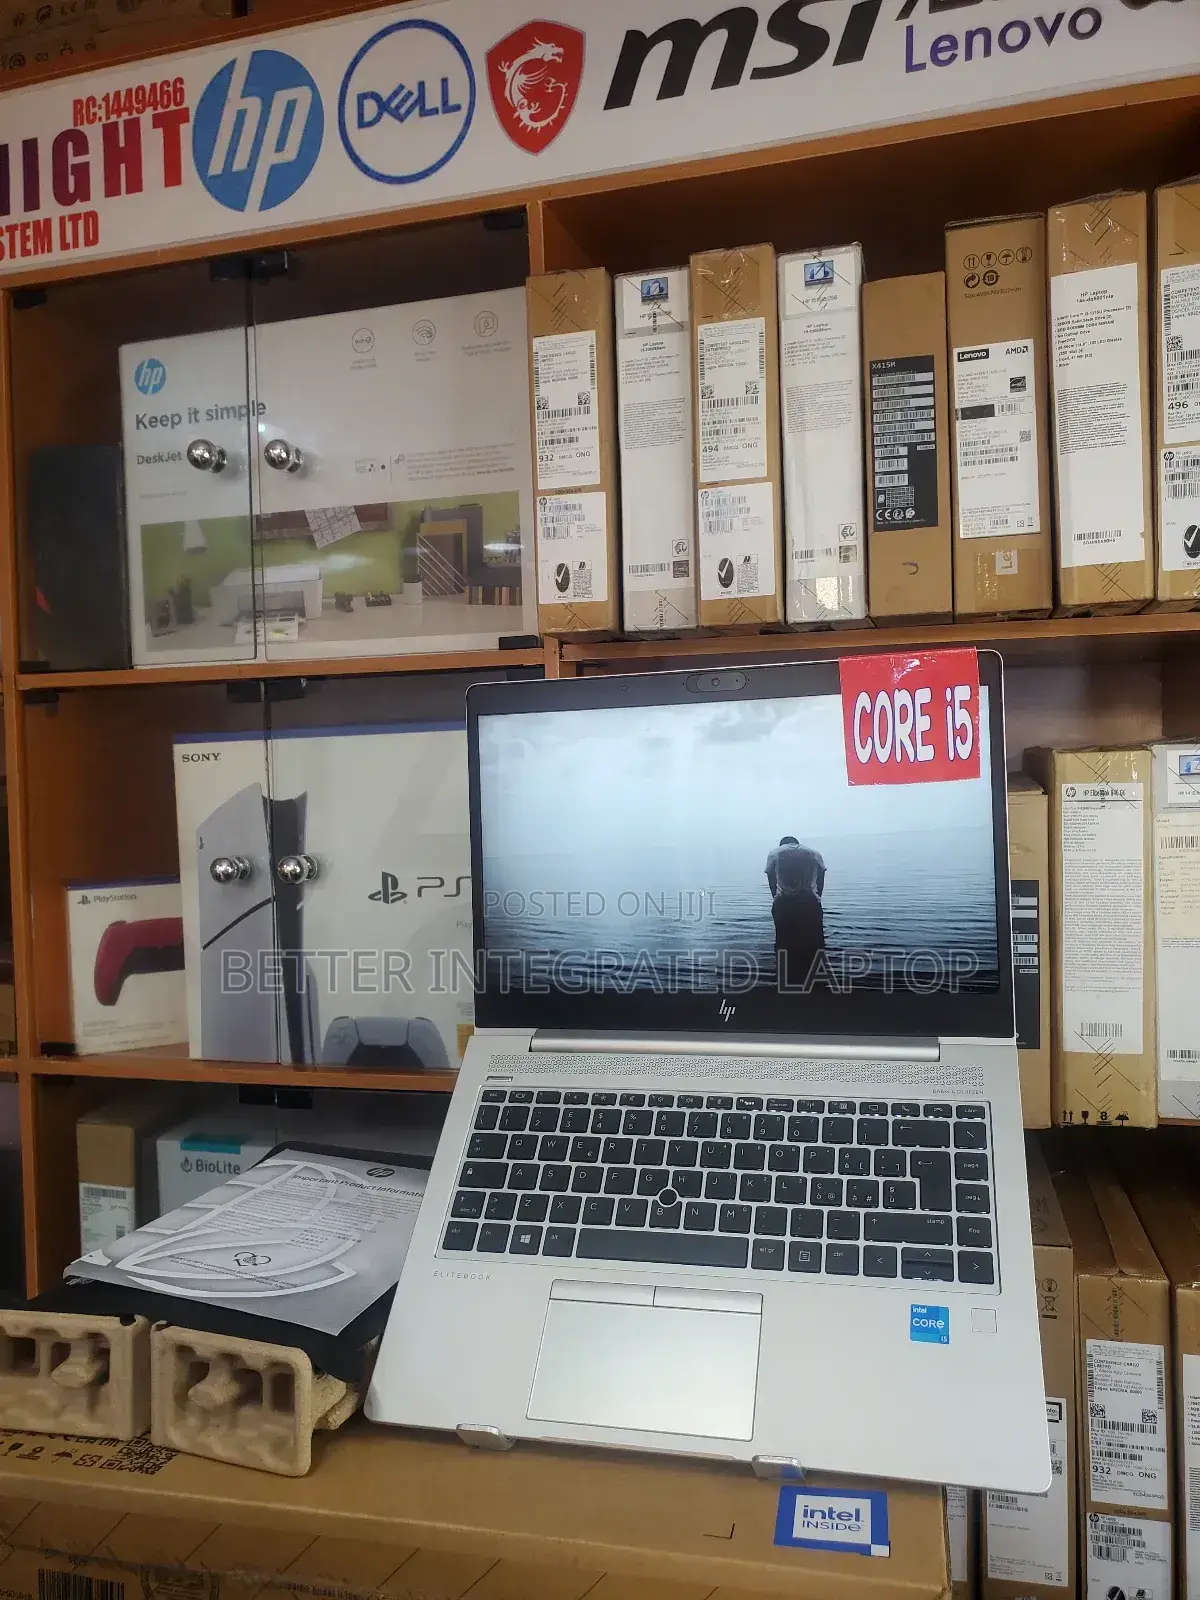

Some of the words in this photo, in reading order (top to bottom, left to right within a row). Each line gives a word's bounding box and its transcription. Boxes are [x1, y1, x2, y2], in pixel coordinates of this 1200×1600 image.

[904, 6, 1103, 74] Lenovo
[603, 0, 882, 111] msi
[72, 76, 186, 127] RC:1449466
[356, 75, 462, 130] DELL
[58, 209, 100, 252] LTD
[1090, 289, 1108, 297] Laptop
[959, 350, 987, 361] Lenovo
[1005, 346, 1022, 356] AMD
[871, 361, 896, 370] X415M
[1167, 400, 1189, 411] 496
[135, 412, 183, 431] Keep
[187, 406, 201, 425] it
[204, 399, 268, 424] simple
[702, 444, 719, 453] 494
[135, 450, 184, 467] DeskJet
[538, 453, 555, 463] 932
[852, 685, 937, 765] CORE
[945, 684, 974, 762] i5
[180, 751, 222, 764] SONY
[93, 893, 138, 904] PlayStation
[534, 1119, 541, 1127] 2
[565, 1120, 571, 1128] 3
[515, 1139, 523, 1147] Q
[608, 1142, 616, 1150] R
[641, 1143, 647, 1151] T
[707, 1146, 715, 1154] U
[775, 1149, 784, 1157] O
[809, 1151, 817, 1159] P
[194, 1157, 242, 1176] BioLite
[292, 1174, 339, 1185] Important
[339, 1180, 377, 1191] Product
[515, 1168, 523, 1176] A
[547, 1169, 554, 1177] S
[579, 1171, 587, 1179] D
[611, 1172, 619, 1180] F
[645, 1173, 653, 1182] G
[678, 1175, 686, 1183] H
[711, 1177, 718, 1185] J
[746, 1179, 754, 1187] K
[781, 1181, 788, 1189] L
[524, 1199, 532, 1207] Z
[556, 1201, 564, 1209] X
[590, 1202, 597, 1210] C
[624, 1204, 632, 1212] V
[656, 1207, 664, 1216] B
[691, 1208, 699, 1216] N
[726, 1209, 736, 1218] M
[926, 1217, 945, 1226] stamp
[433, 1270, 492, 1281] ELITEBOOK
[912, 1306, 928, 1314] intel
[1092, 1465, 1112, 1475] 932
[1138, 1471, 1157, 1480] ONG
[802, 1504, 865, 1524] intel
